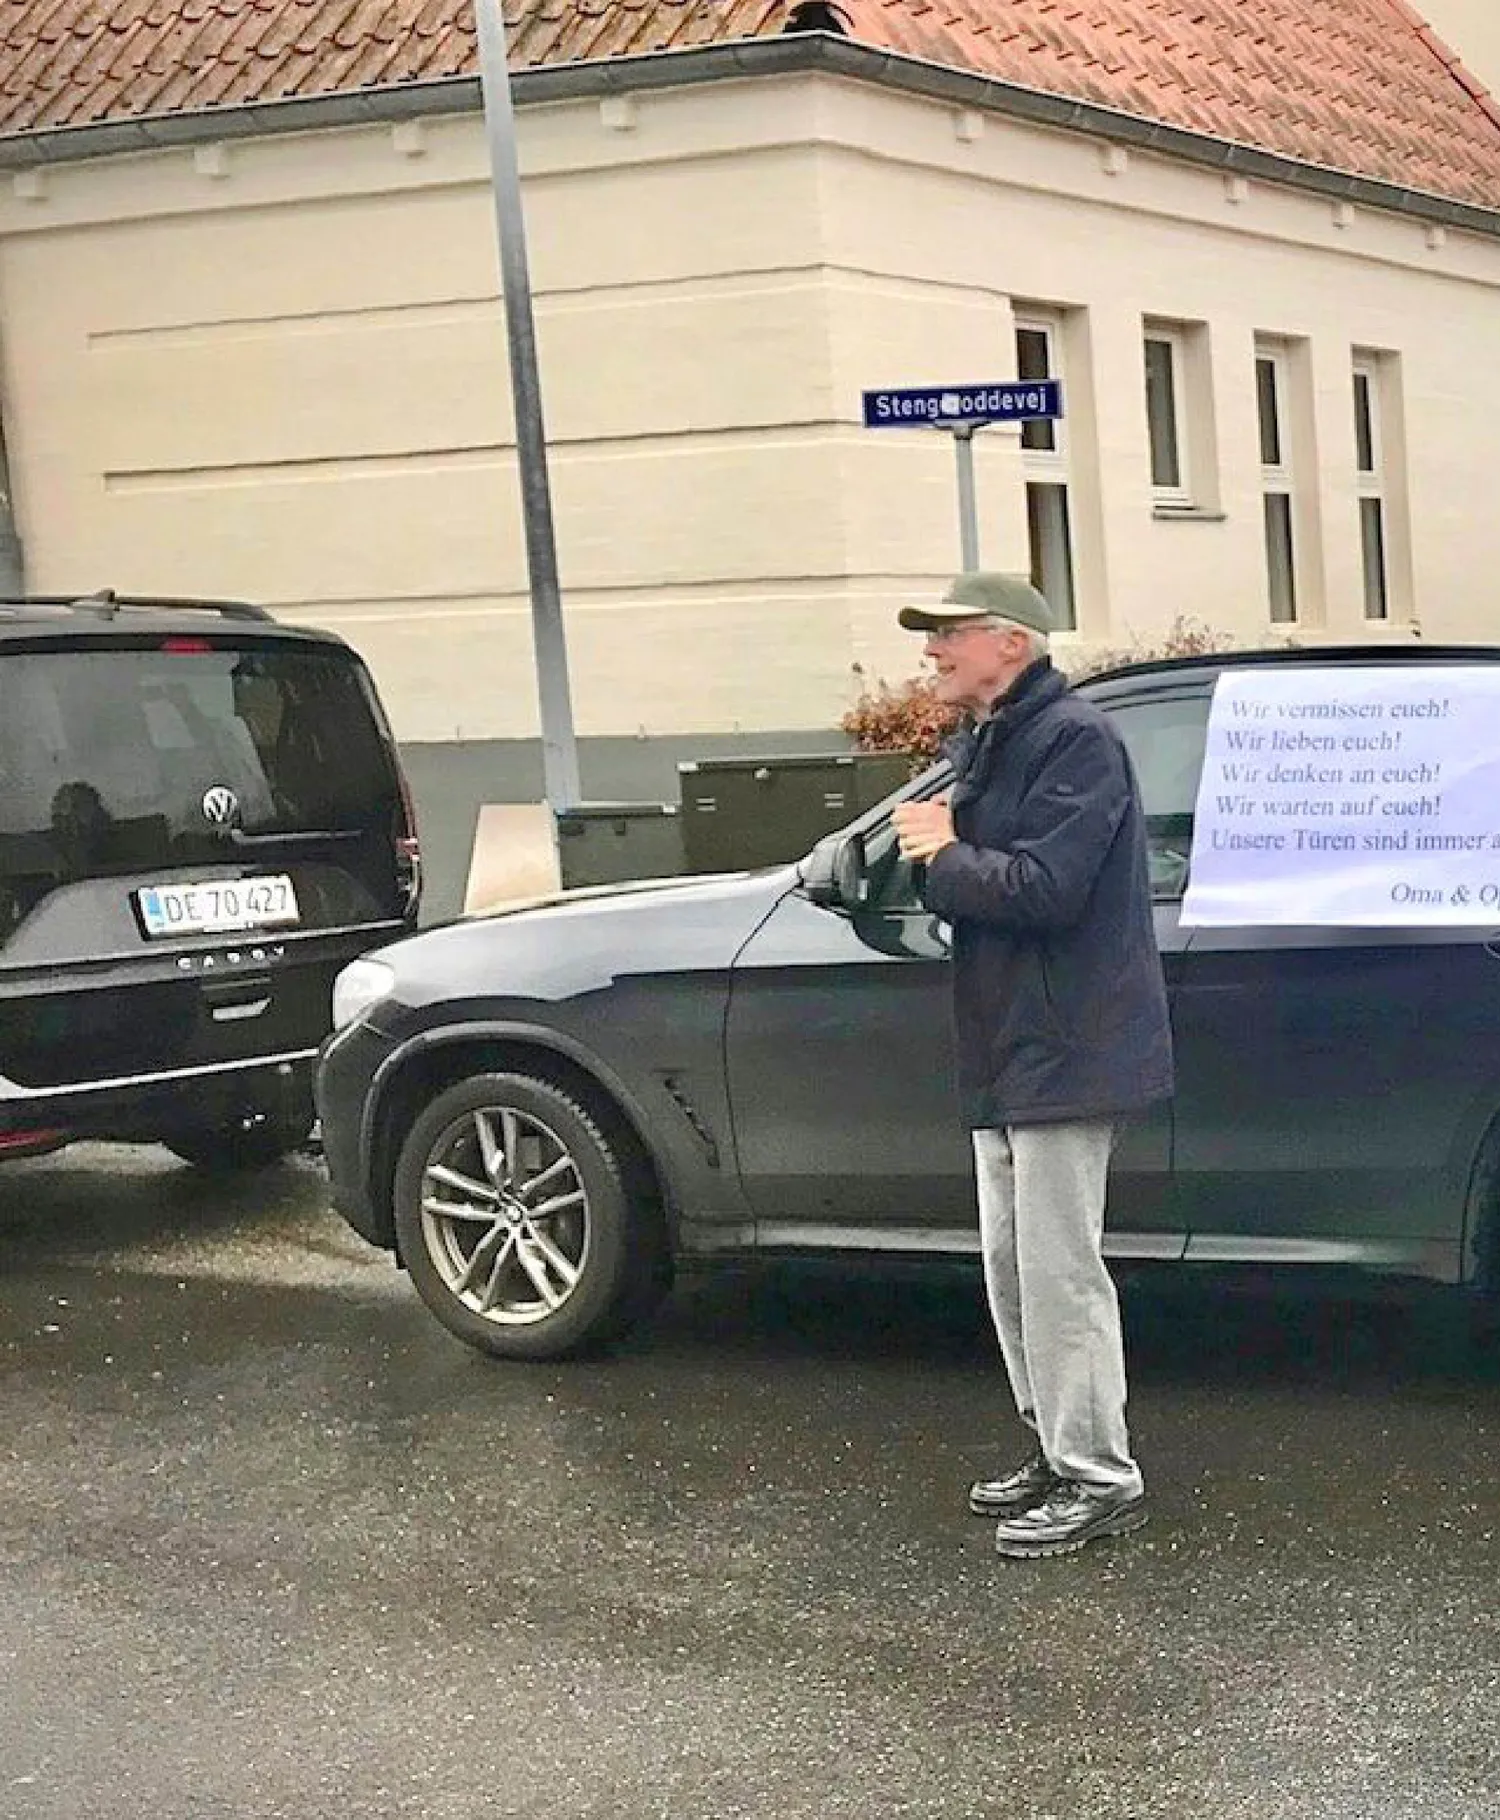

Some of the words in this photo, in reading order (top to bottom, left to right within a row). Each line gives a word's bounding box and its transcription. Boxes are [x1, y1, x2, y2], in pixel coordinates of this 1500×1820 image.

[876, 386, 1046, 418] Stengoddevej
[1232, 700, 1269, 719] Wir
[1277, 698, 1383, 719] vermissen
[1391, 699, 1450, 719] euch!
[1227, 730, 1265, 750] Wir
[1272, 730, 1335, 750] lieben
[1342, 730, 1402, 750] euch!
[1222, 762, 1260, 782] Wir
[1267, 763, 1343, 782] denken
[1350, 768, 1374, 782] an
[1382, 763, 1440, 782] euch!
[1216, 795, 1256, 816] Wir
[1263, 799, 1334, 815] warten
[1340, 795, 1380, 815] auf
[1382, 795, 1441, 816] euch!
[1211, 828, 1285, 850] Unsere
[1293, 828, 1355, 850] Türen
[1362, 829, 1407, 850] sind
[1416, 829, 1486, 850] immer
[164, 892, 202, 923] DE
[206, 889, 240, 918] 70
[246, 884, 287, 914] 427
[1391, 882, 1443, 902] Oma
[1450, 884, 1471, 906] &
